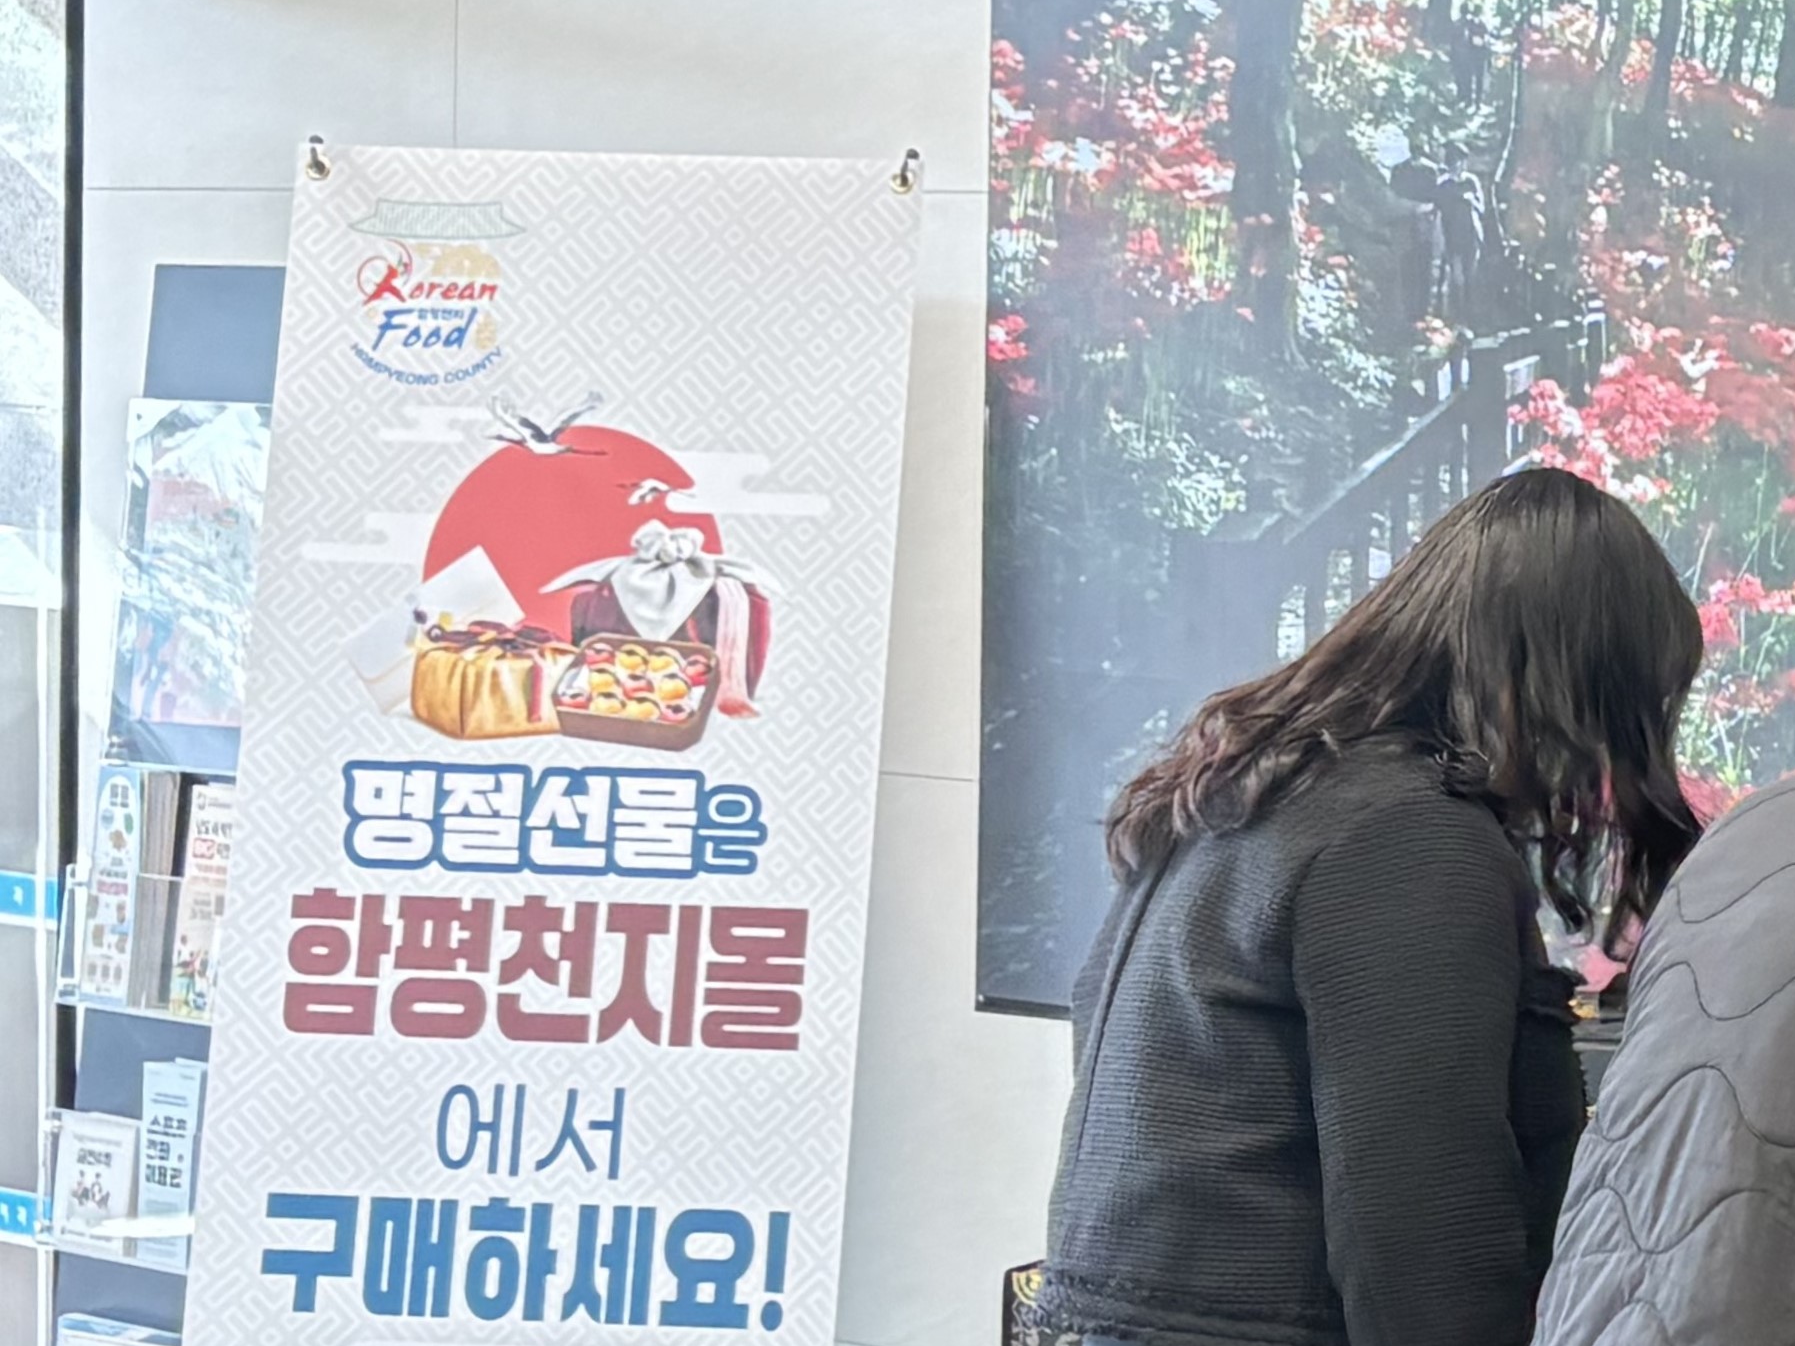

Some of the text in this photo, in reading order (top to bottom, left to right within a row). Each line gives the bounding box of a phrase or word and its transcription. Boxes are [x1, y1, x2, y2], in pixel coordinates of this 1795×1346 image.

[361, 262, 498, 307] Korean
[371, 306, 478, 352] Food
[443, 344, 503, 384] COUNTY
[342, 759, 768, 879] 명절선물은
[282, 887, 809, 1051] 함평천지몰
[435, 1082, 626, 1180] 에서
[260, 1191, 791, 1332] 구매하세요!
